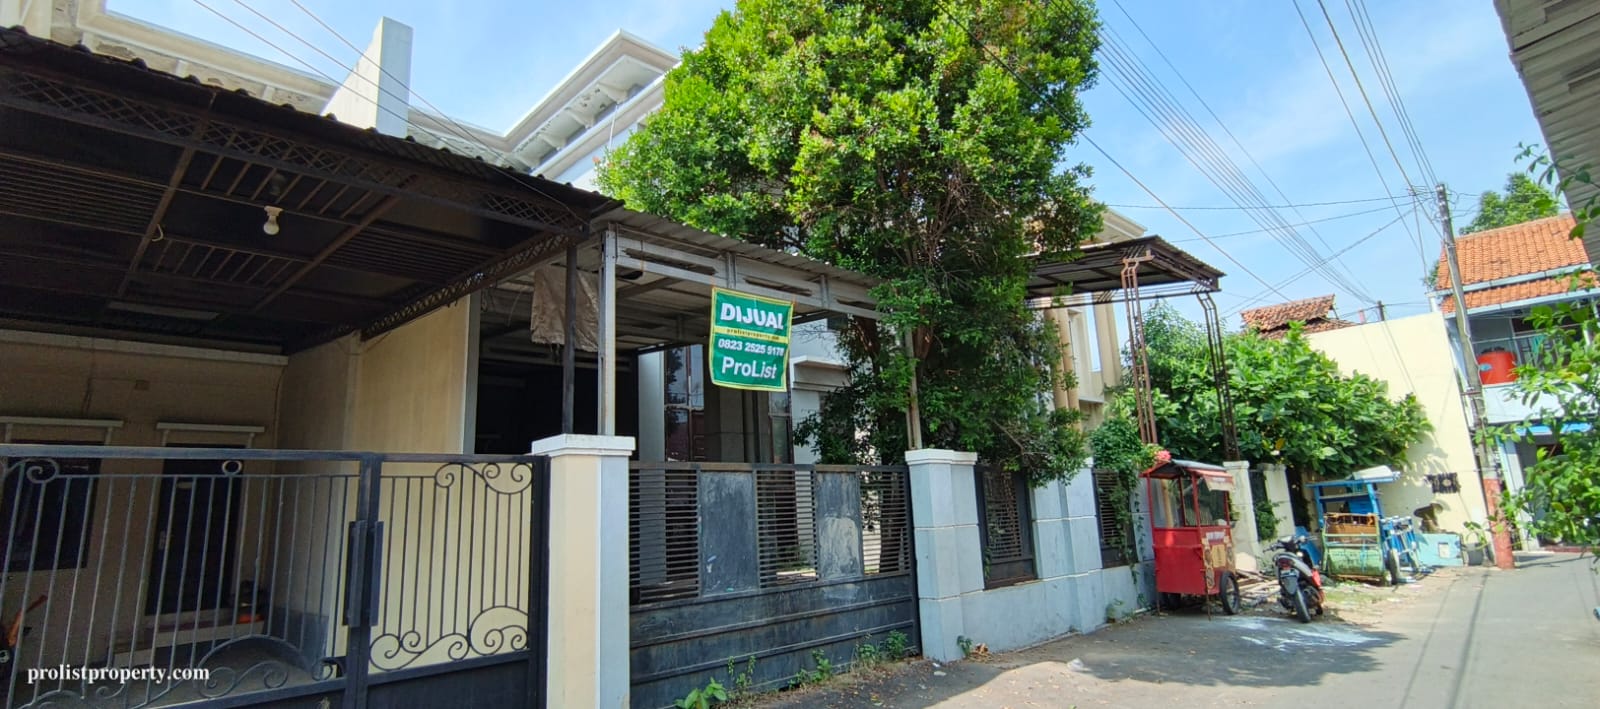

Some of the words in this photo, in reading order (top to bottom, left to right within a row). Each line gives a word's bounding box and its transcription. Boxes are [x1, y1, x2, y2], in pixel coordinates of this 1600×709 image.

[720, 303, 783, 330] DIJUAL
[718, 338, 743, 350] 0823
[744, 342, 766, 353] 2525
[721, 356, 777, 379] ProList
